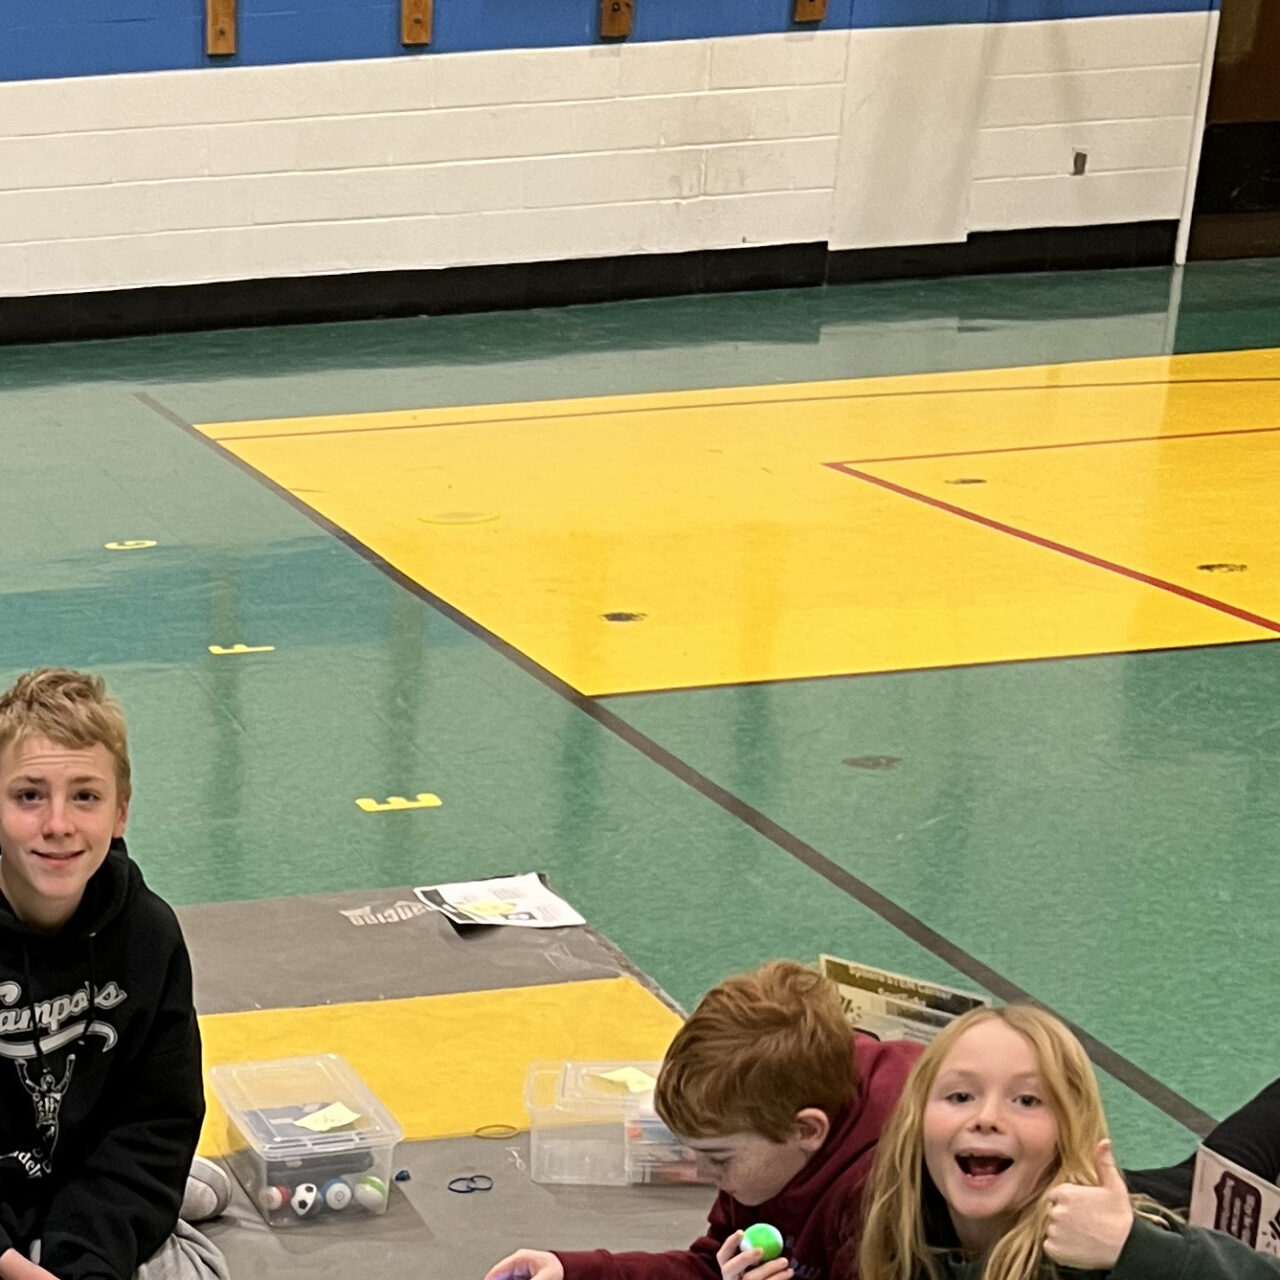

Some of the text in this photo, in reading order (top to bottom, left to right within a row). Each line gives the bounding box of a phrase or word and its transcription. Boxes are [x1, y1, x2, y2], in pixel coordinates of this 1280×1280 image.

[104, 540, 157, 550] G
[208, 644, 275, 655] F
[355, 793, 443, 812] E
